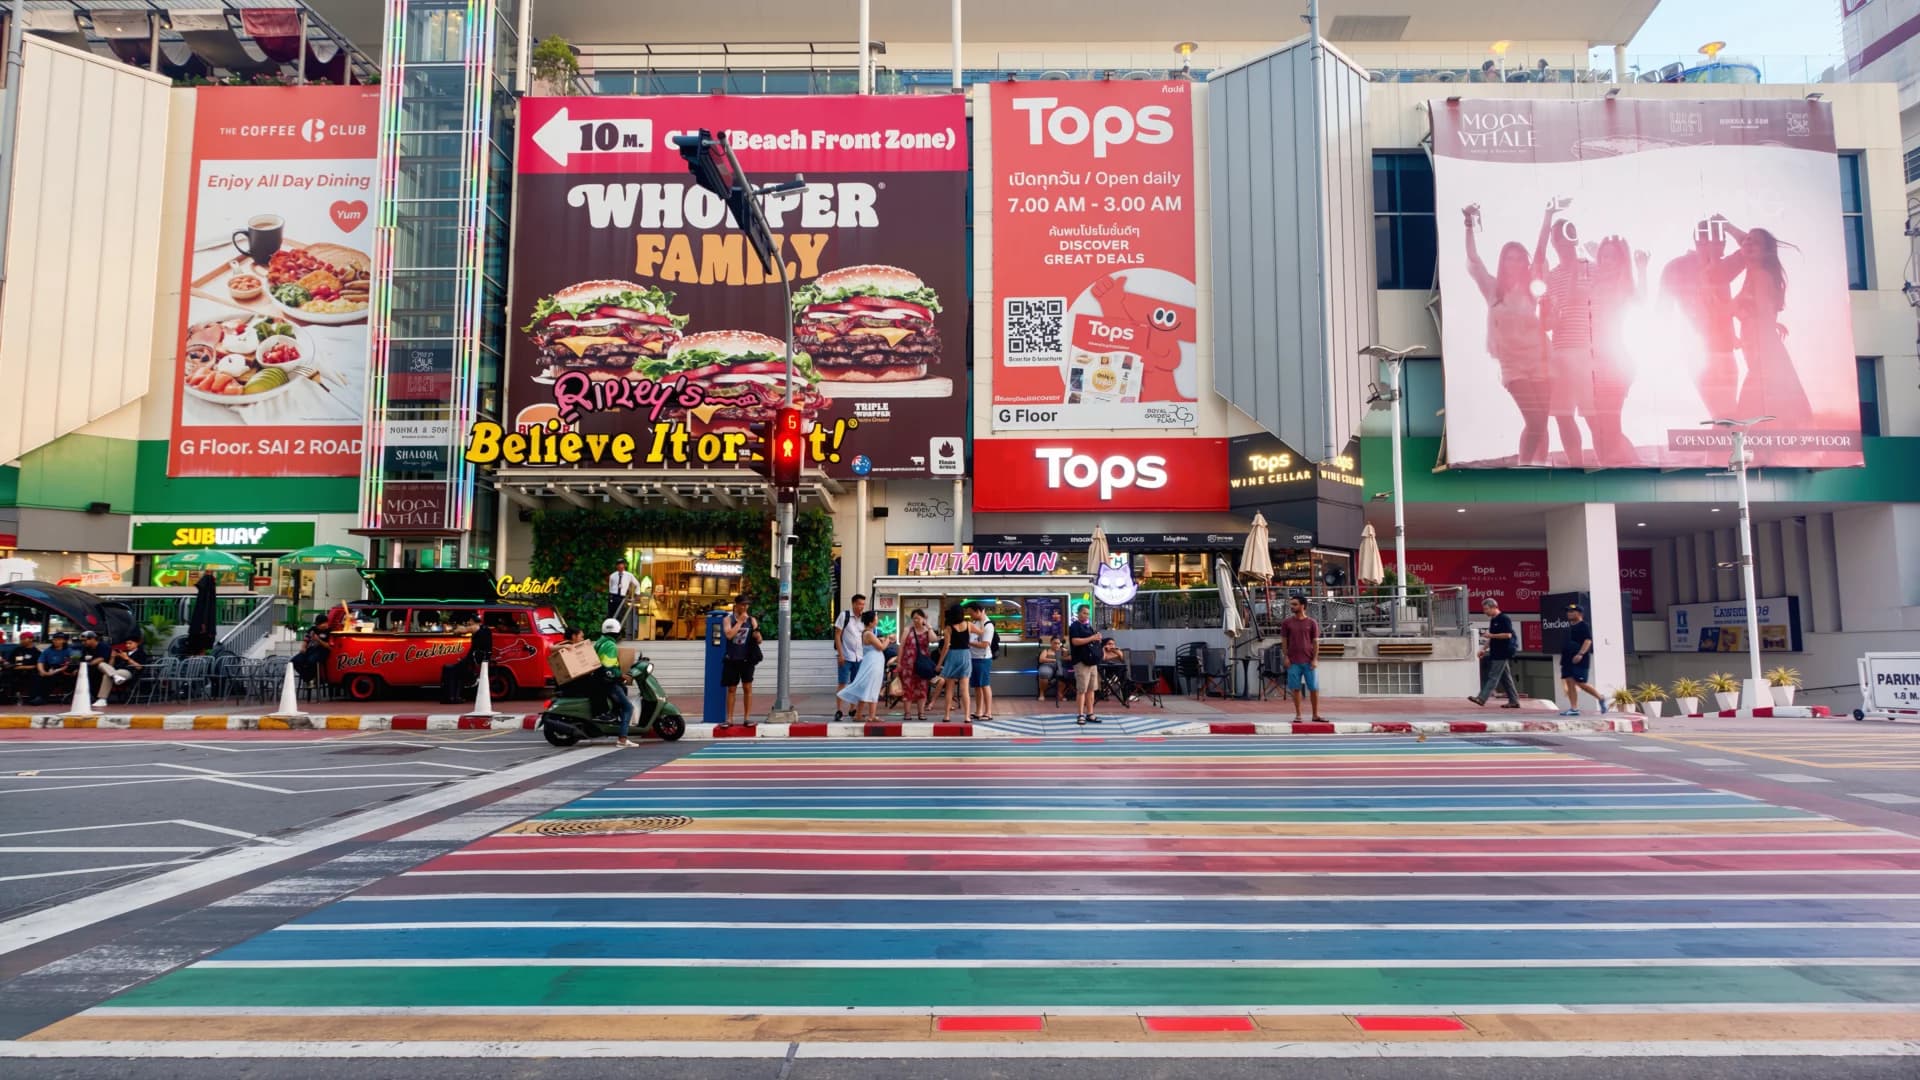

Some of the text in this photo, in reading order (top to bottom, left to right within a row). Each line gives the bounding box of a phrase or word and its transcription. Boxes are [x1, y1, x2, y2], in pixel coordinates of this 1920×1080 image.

[240, 125, 296, 136] COFFEE
[329, 124, 367, 136] CLUB
[1012, 97, 1174, 158] Tops
[1462, 113, 1533, 130] MOON
[579, 122, 620, 152] 10
[811, 129, 882, 151] Front
[885, 127, 957, 152] Zone)
[1457, 130, 1538, 147] WHALE
[207, 172, 371, 191] Enjoy All Day Dining
[1009, 172, 1081, 191] เปิดทุกวัน
[1095, 173, 1139, 188] Open
[1143, 171, 1182, 188] daily
[567, 182, 879, 229] WHOPER
[1008, 197, 1050, 213] 7.00
[1054, 197, 1086, 212] AM
[1104, 196, 1146, 212] 3.00
[1151, 196, 1182, 211] AM
[337, 209, 361, 220] Yum
[1059, 240, 1130, 251] DISCOVER
[1044, 253, 1145, 266] GREAT DEALS
[1088, 319, 1135, 342] Tops
[854, 402, 889, 411] TRIPLE
[999, 408, 1059, 423] G Floor
[180, 439, 194, 454] G
[200, 438, 252, 455] Floor.
[258, 439, 289, 454] SAI
[294, 440, 305, 454] 2
[466, 421, 636, 465] Believe
[647, 421, 689, 464] It
[697, 431, 747, 464] or
[1248, 453, 1291, 473] Tops
[1035, 448, 1169, 500] Tops
[1231, 470, 1312, 488] WINE CELLAR
[387, 499, 440, 511] MOON
[383, 511, 442, 524] WHALE
[172, 526, 270, 546] SUBWAY
[1472, 565, 1496, 576] Tops
[496, 575, 553, 597] Cocktail
[336, 640, 466, 671] Red Car Cocktail
